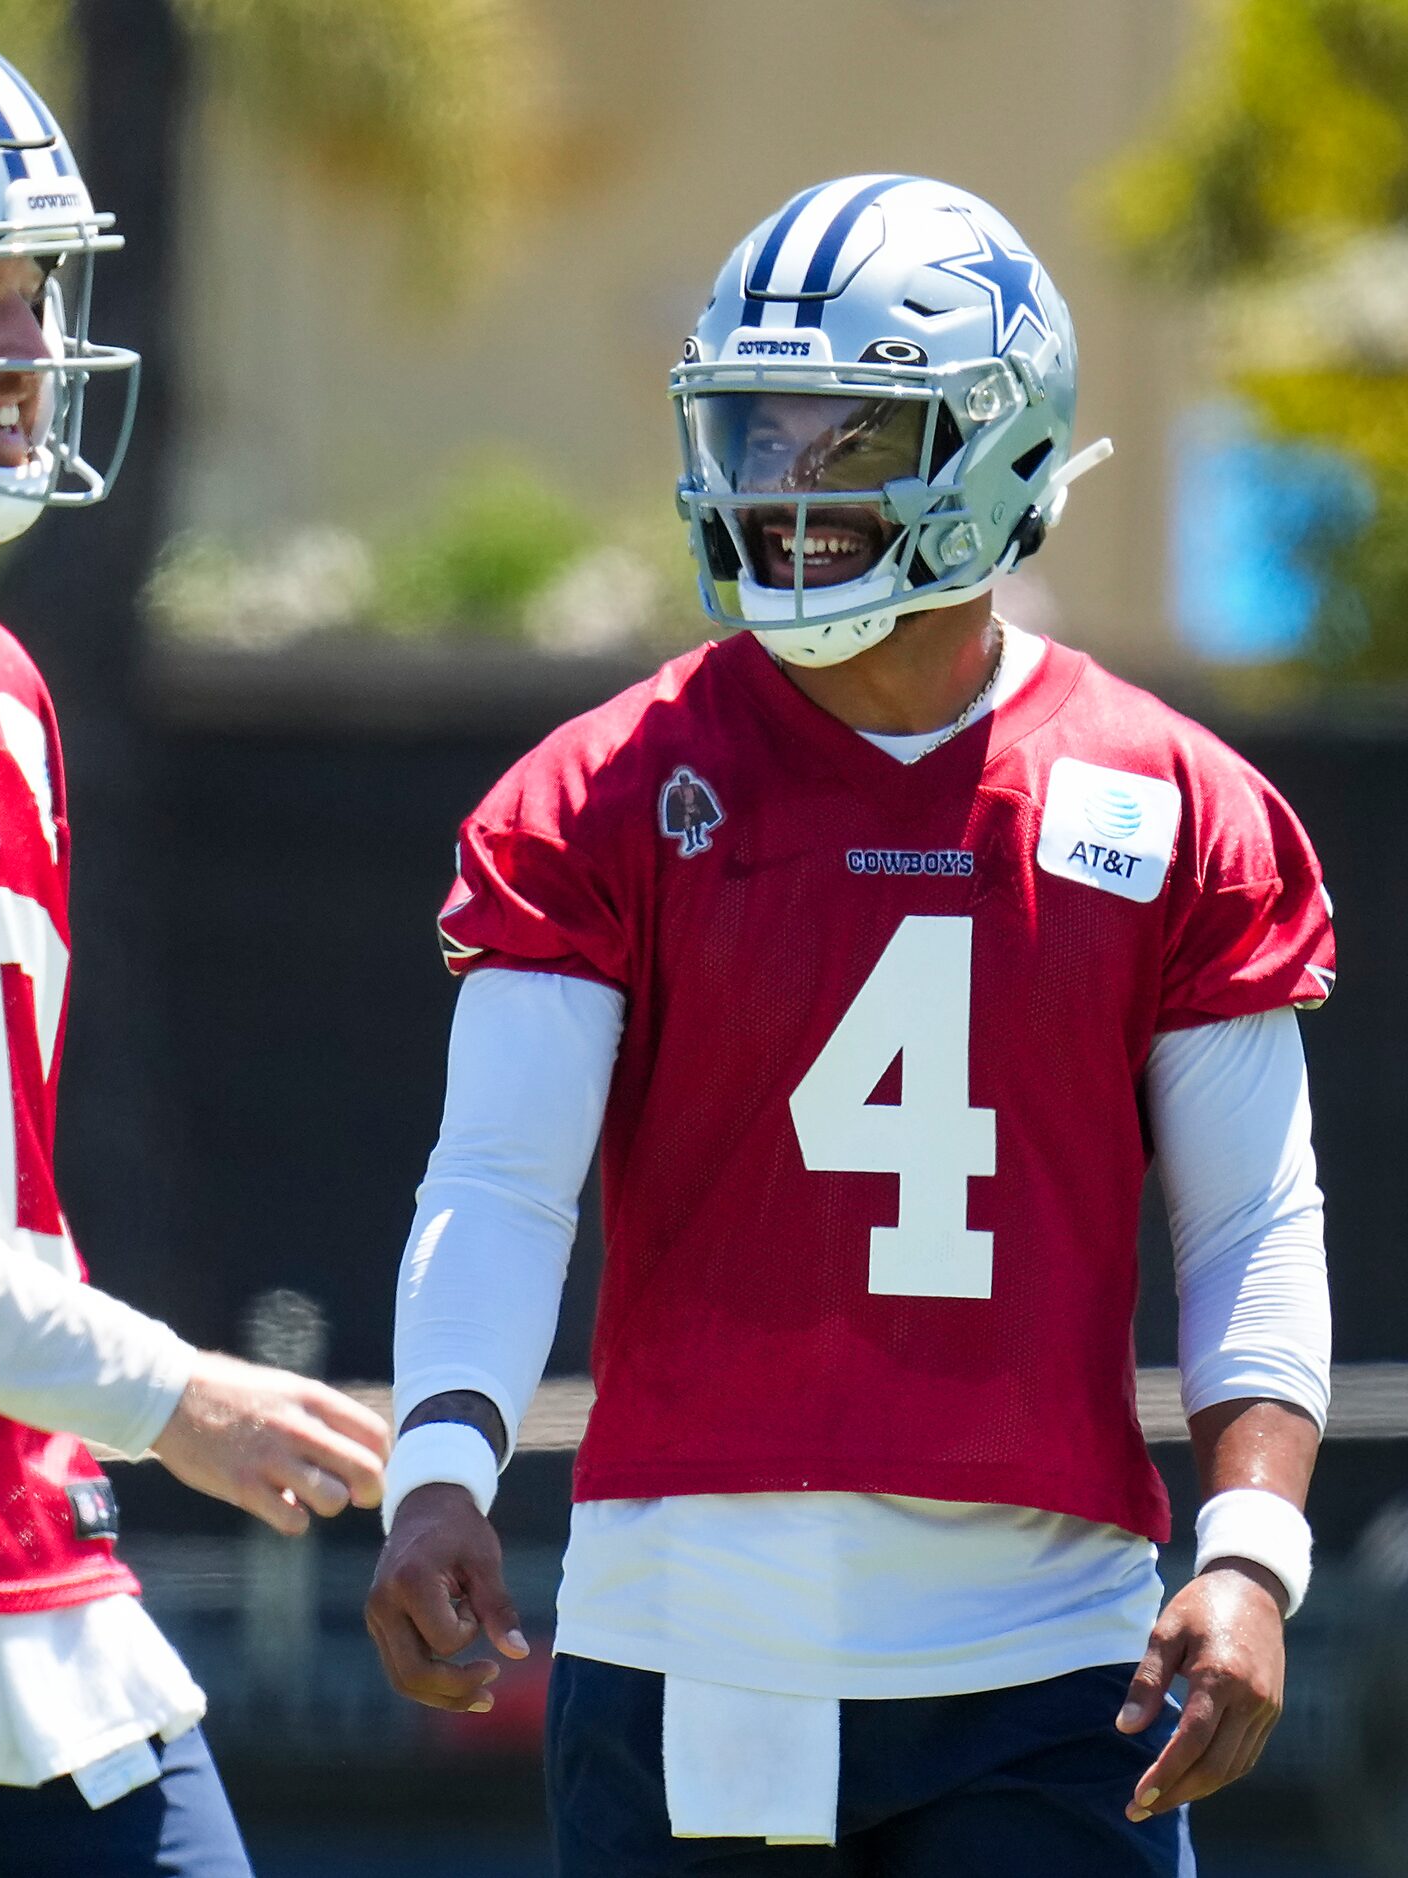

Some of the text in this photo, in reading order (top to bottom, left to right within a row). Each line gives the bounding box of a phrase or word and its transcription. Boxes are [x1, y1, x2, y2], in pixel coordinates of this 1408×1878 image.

[737, 341, 811, 356] COWBOYS
[846, 849, 974, 876] COWBOYS
[1067, 840, 1142, 879] AT&T
[789, 915, 996, 1299] 4
